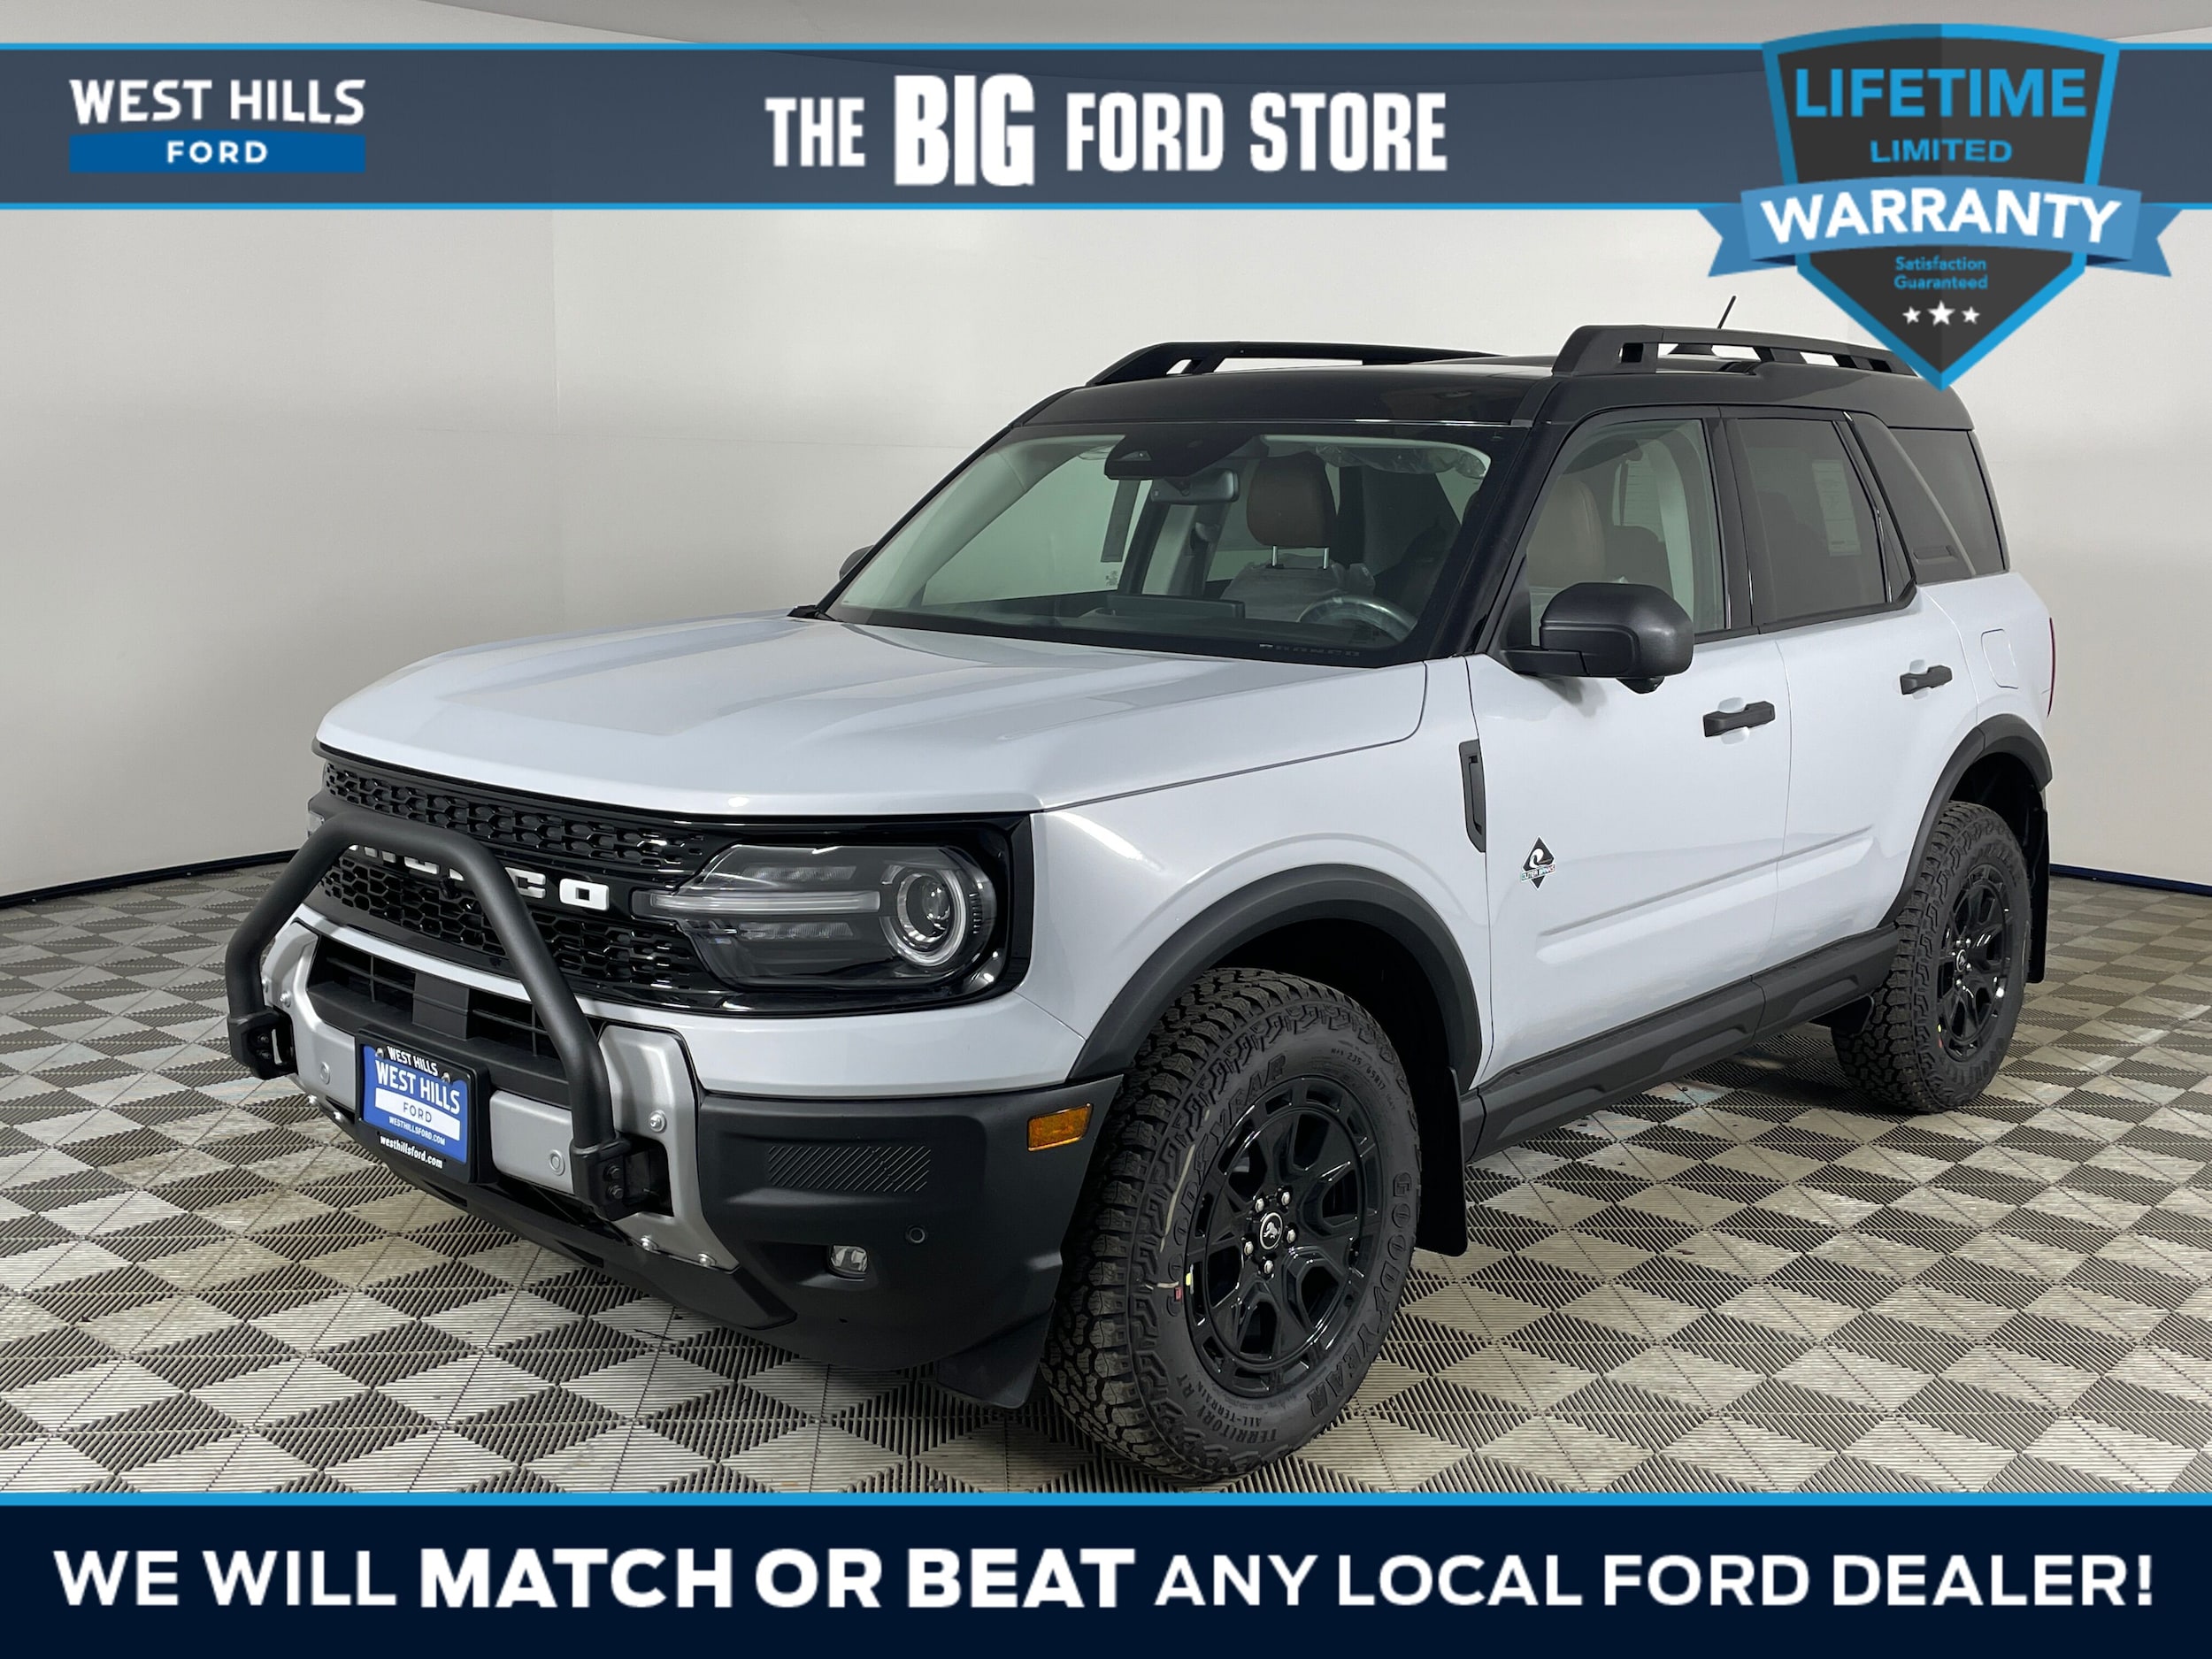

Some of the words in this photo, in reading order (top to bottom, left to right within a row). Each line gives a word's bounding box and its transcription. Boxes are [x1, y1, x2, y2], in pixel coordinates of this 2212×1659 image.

[387, 1046, 413, 1066] WEST
[412, 1055, 439, 1077] HILLS
[375, 1060, 416, 1094] WEST
[419, 1077, 460, 1115] HILLS
[403, 1102, 433, 1123] FORD
[388, 1116, 446, 1146] WESTHILLSFORD.COM
[380, 1135, 442, 1169] westhillsford.com
[1307, 1171, 1412, 1417] GOODYEAR
[1196, 1380, 1263, 1428] ALL-TERRAIN
[1195, 1405, 1278, 1444] TERRITORY
